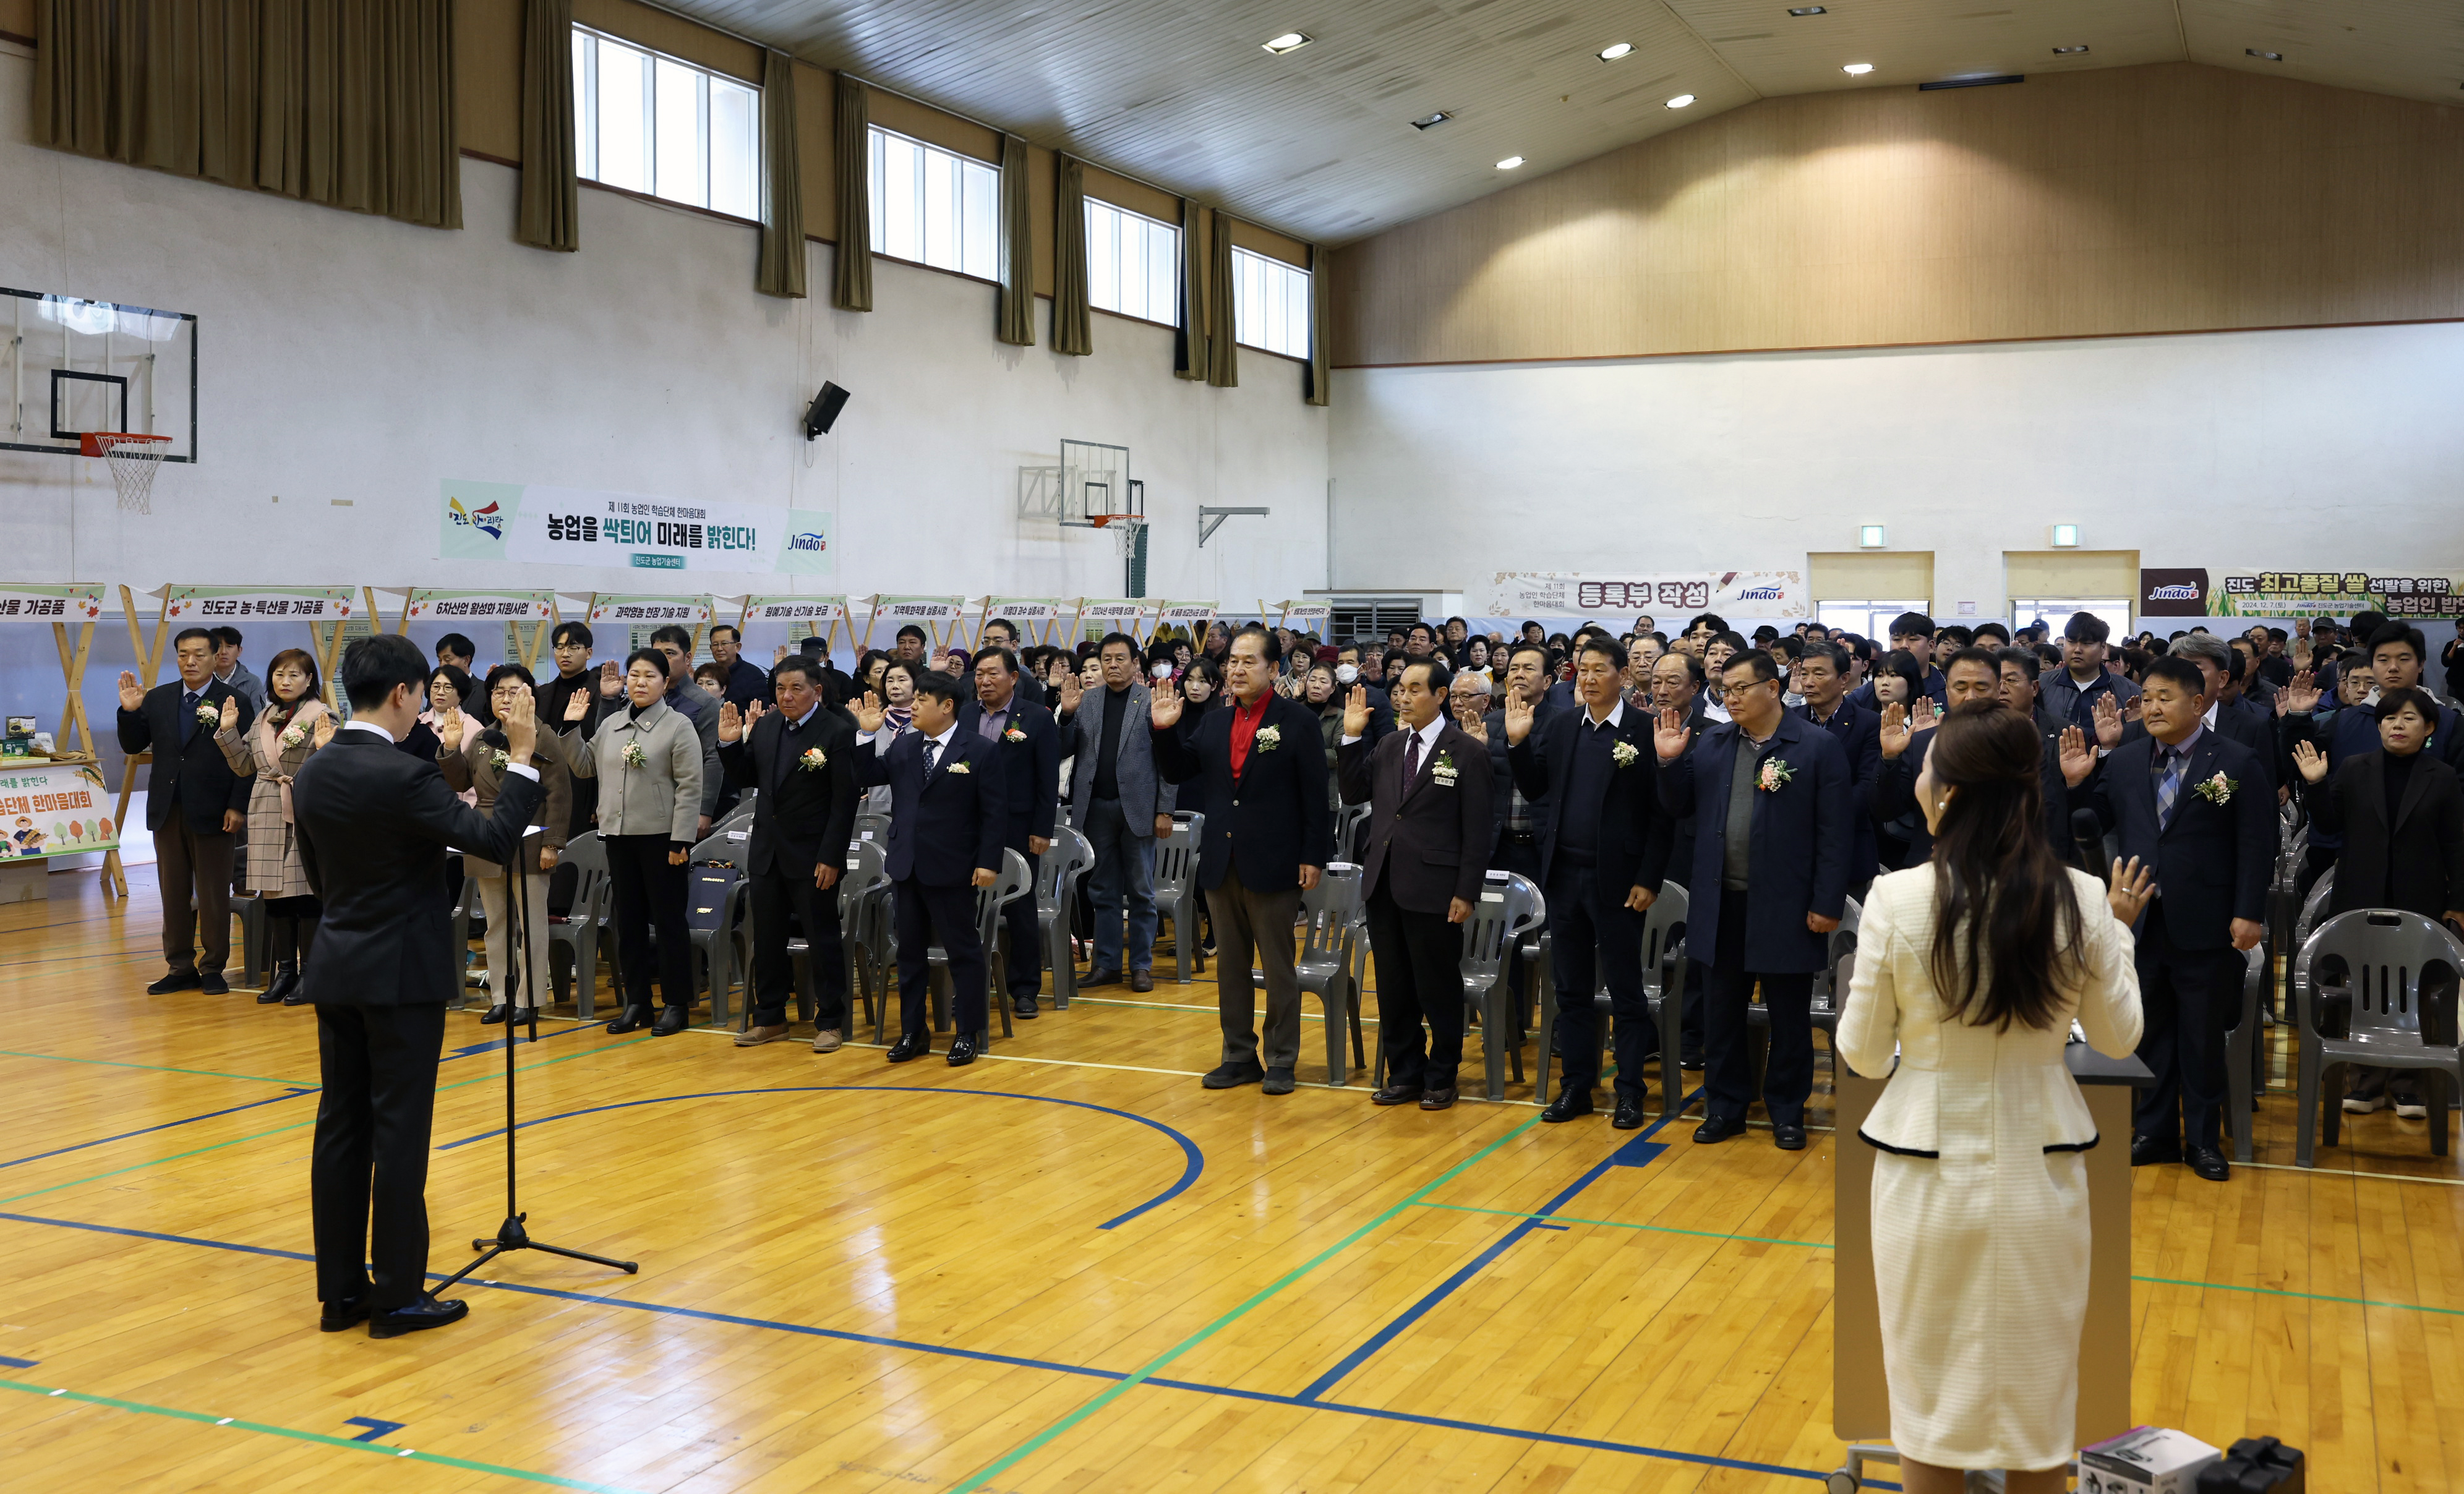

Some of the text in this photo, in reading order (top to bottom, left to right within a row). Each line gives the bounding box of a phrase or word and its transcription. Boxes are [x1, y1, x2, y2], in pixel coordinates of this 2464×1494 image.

[609, 502, 706, 519] 제 11회 농업인 학습단체 한마음대회
[547, 513, 756, 551] 농업을 싹틔어 미래를 밝힌다!
[787, 534, 820, 551] Jindo
[635, 556, 680, 567] 진도군 농업기술센터
[2227, 574, 2448, 593] 진도 최고품질 쌀 선발을 위한
[1579, 583, 1708, 607] 등록부 작성
[1737, 589, 1777, 600] Jindo
[2149, 587, 2190, 599] Jindo
[24, 600, 66, 615] 가공품
[202, 600, 324, 615] 진도군 농·특산물 가공품
[436, 602, 529, 615] 6차산업 활성화 지원사업
[765, 605, 828, 617] 원예기술 신기술 보급
[893, 605, 948, 615] 지역특화작물 실증시험
[1003, 606, 1046, 615] 아열대 과수 실증시험
[1092, 607, 1108, 615] 2024년
[1108, 607, 1124, 615] 식량작물
[2387, 597, 2436, 613] 농업인
[615, 607, 690, 618] 과학영농 현장 기술 지원
[0, 775, 48, 788] 래를 밝힌다
[32, 791, 93, 813] 한마음대회
